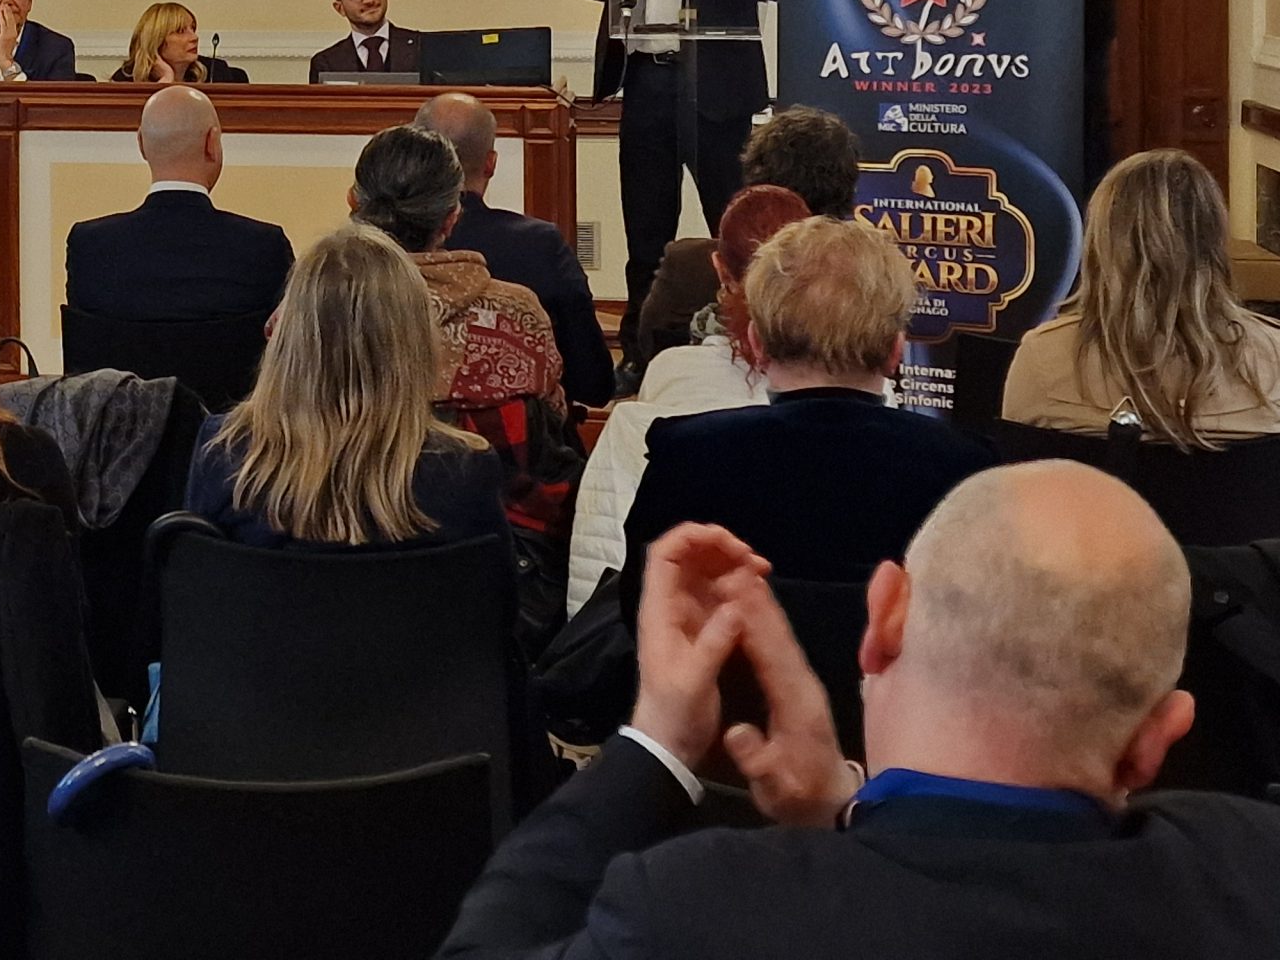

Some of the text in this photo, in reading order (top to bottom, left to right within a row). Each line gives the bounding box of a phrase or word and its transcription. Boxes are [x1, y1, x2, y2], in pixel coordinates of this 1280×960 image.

[855, 80, 993, 94] WINNER 2023
[909, 103, 967, 114] MINISTERO
[909, 123, 967, 134] CULTURA
[874, 198, 981, 212] INTERNATIONAL
[854, 205, 996, 248] SALIERI
[906, 246, 973, 261] RCUS
[909, 259, 998, 294] ARD
[934, 299, 945, 307] DI
[909, 306, 949, 316] GNAGO
